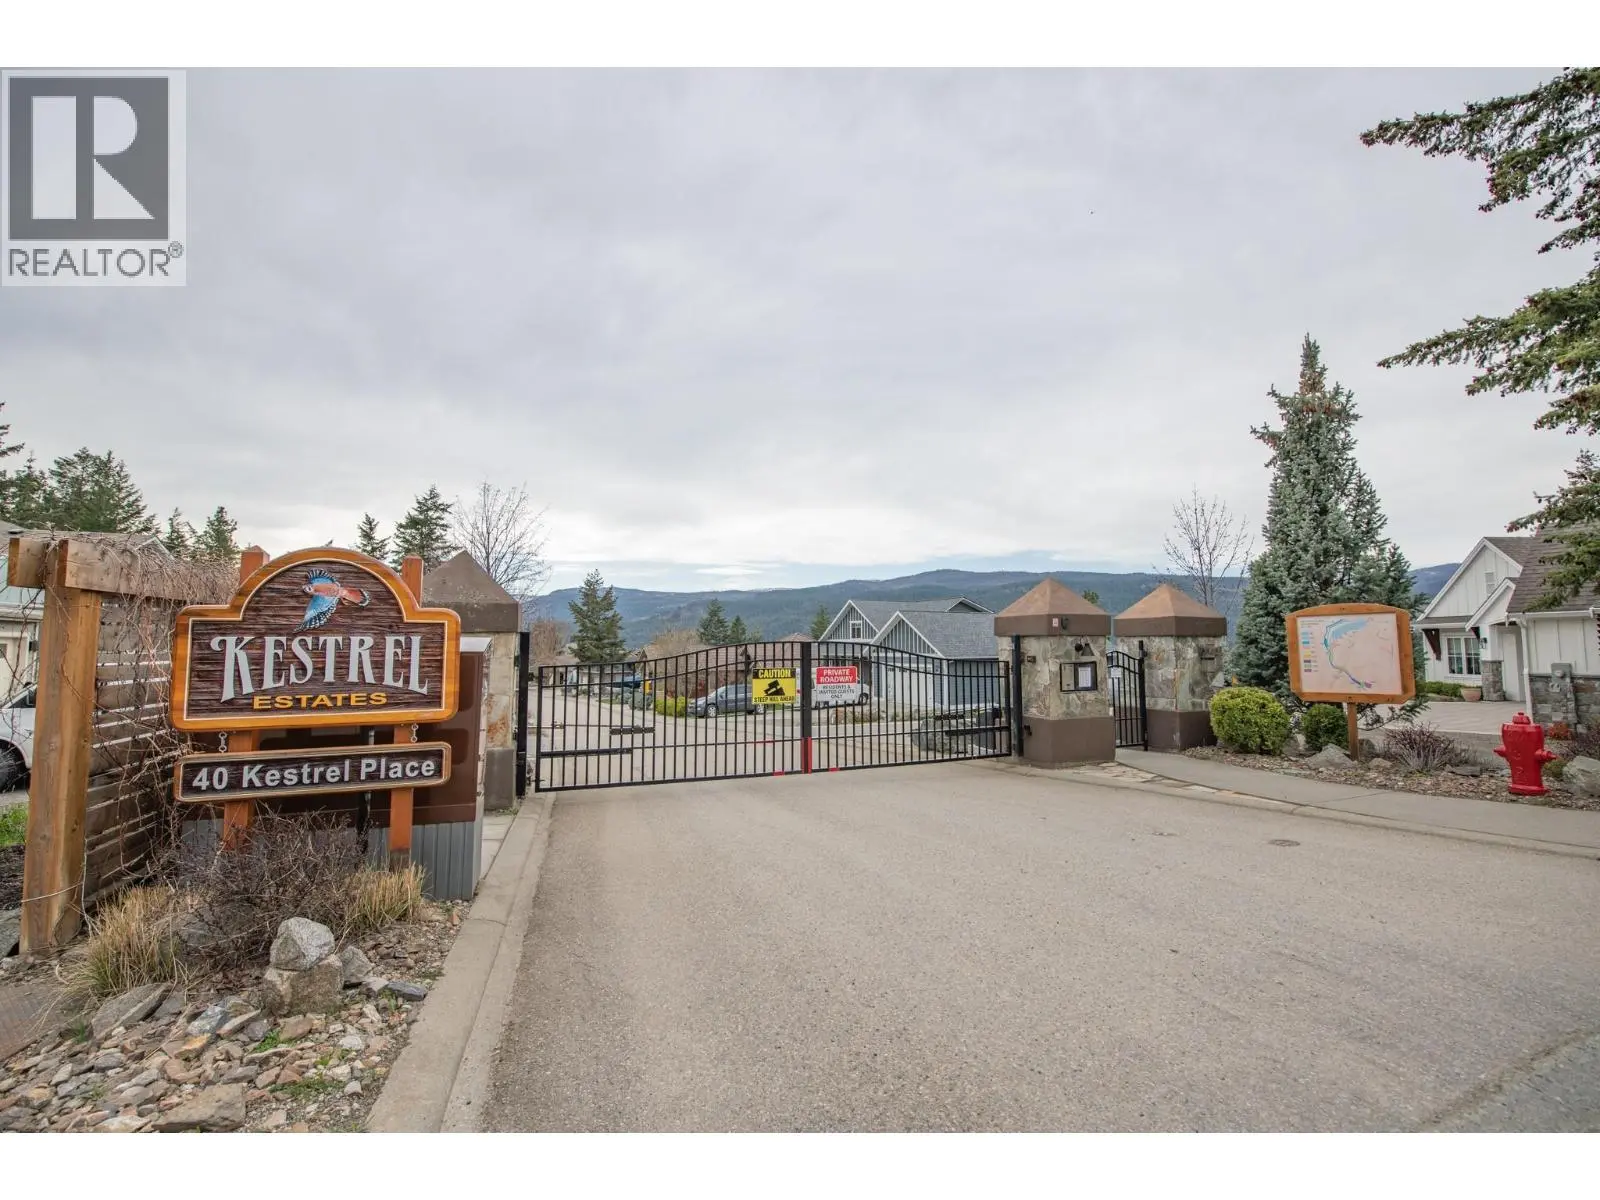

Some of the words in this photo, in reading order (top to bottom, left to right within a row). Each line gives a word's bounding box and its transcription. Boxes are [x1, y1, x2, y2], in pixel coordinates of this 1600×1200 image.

[210, 635, 428, 703] KESTREL
[758, 669, 792, 678] CAUTION
[823, 668, 850, 676] PRIVATE
[253, 692, 388, 710] ESTATES
[192, 766, 229, 791] 40
[242, 758, 350, 788] Kestrel
[360, 757, 436, 780] Place
